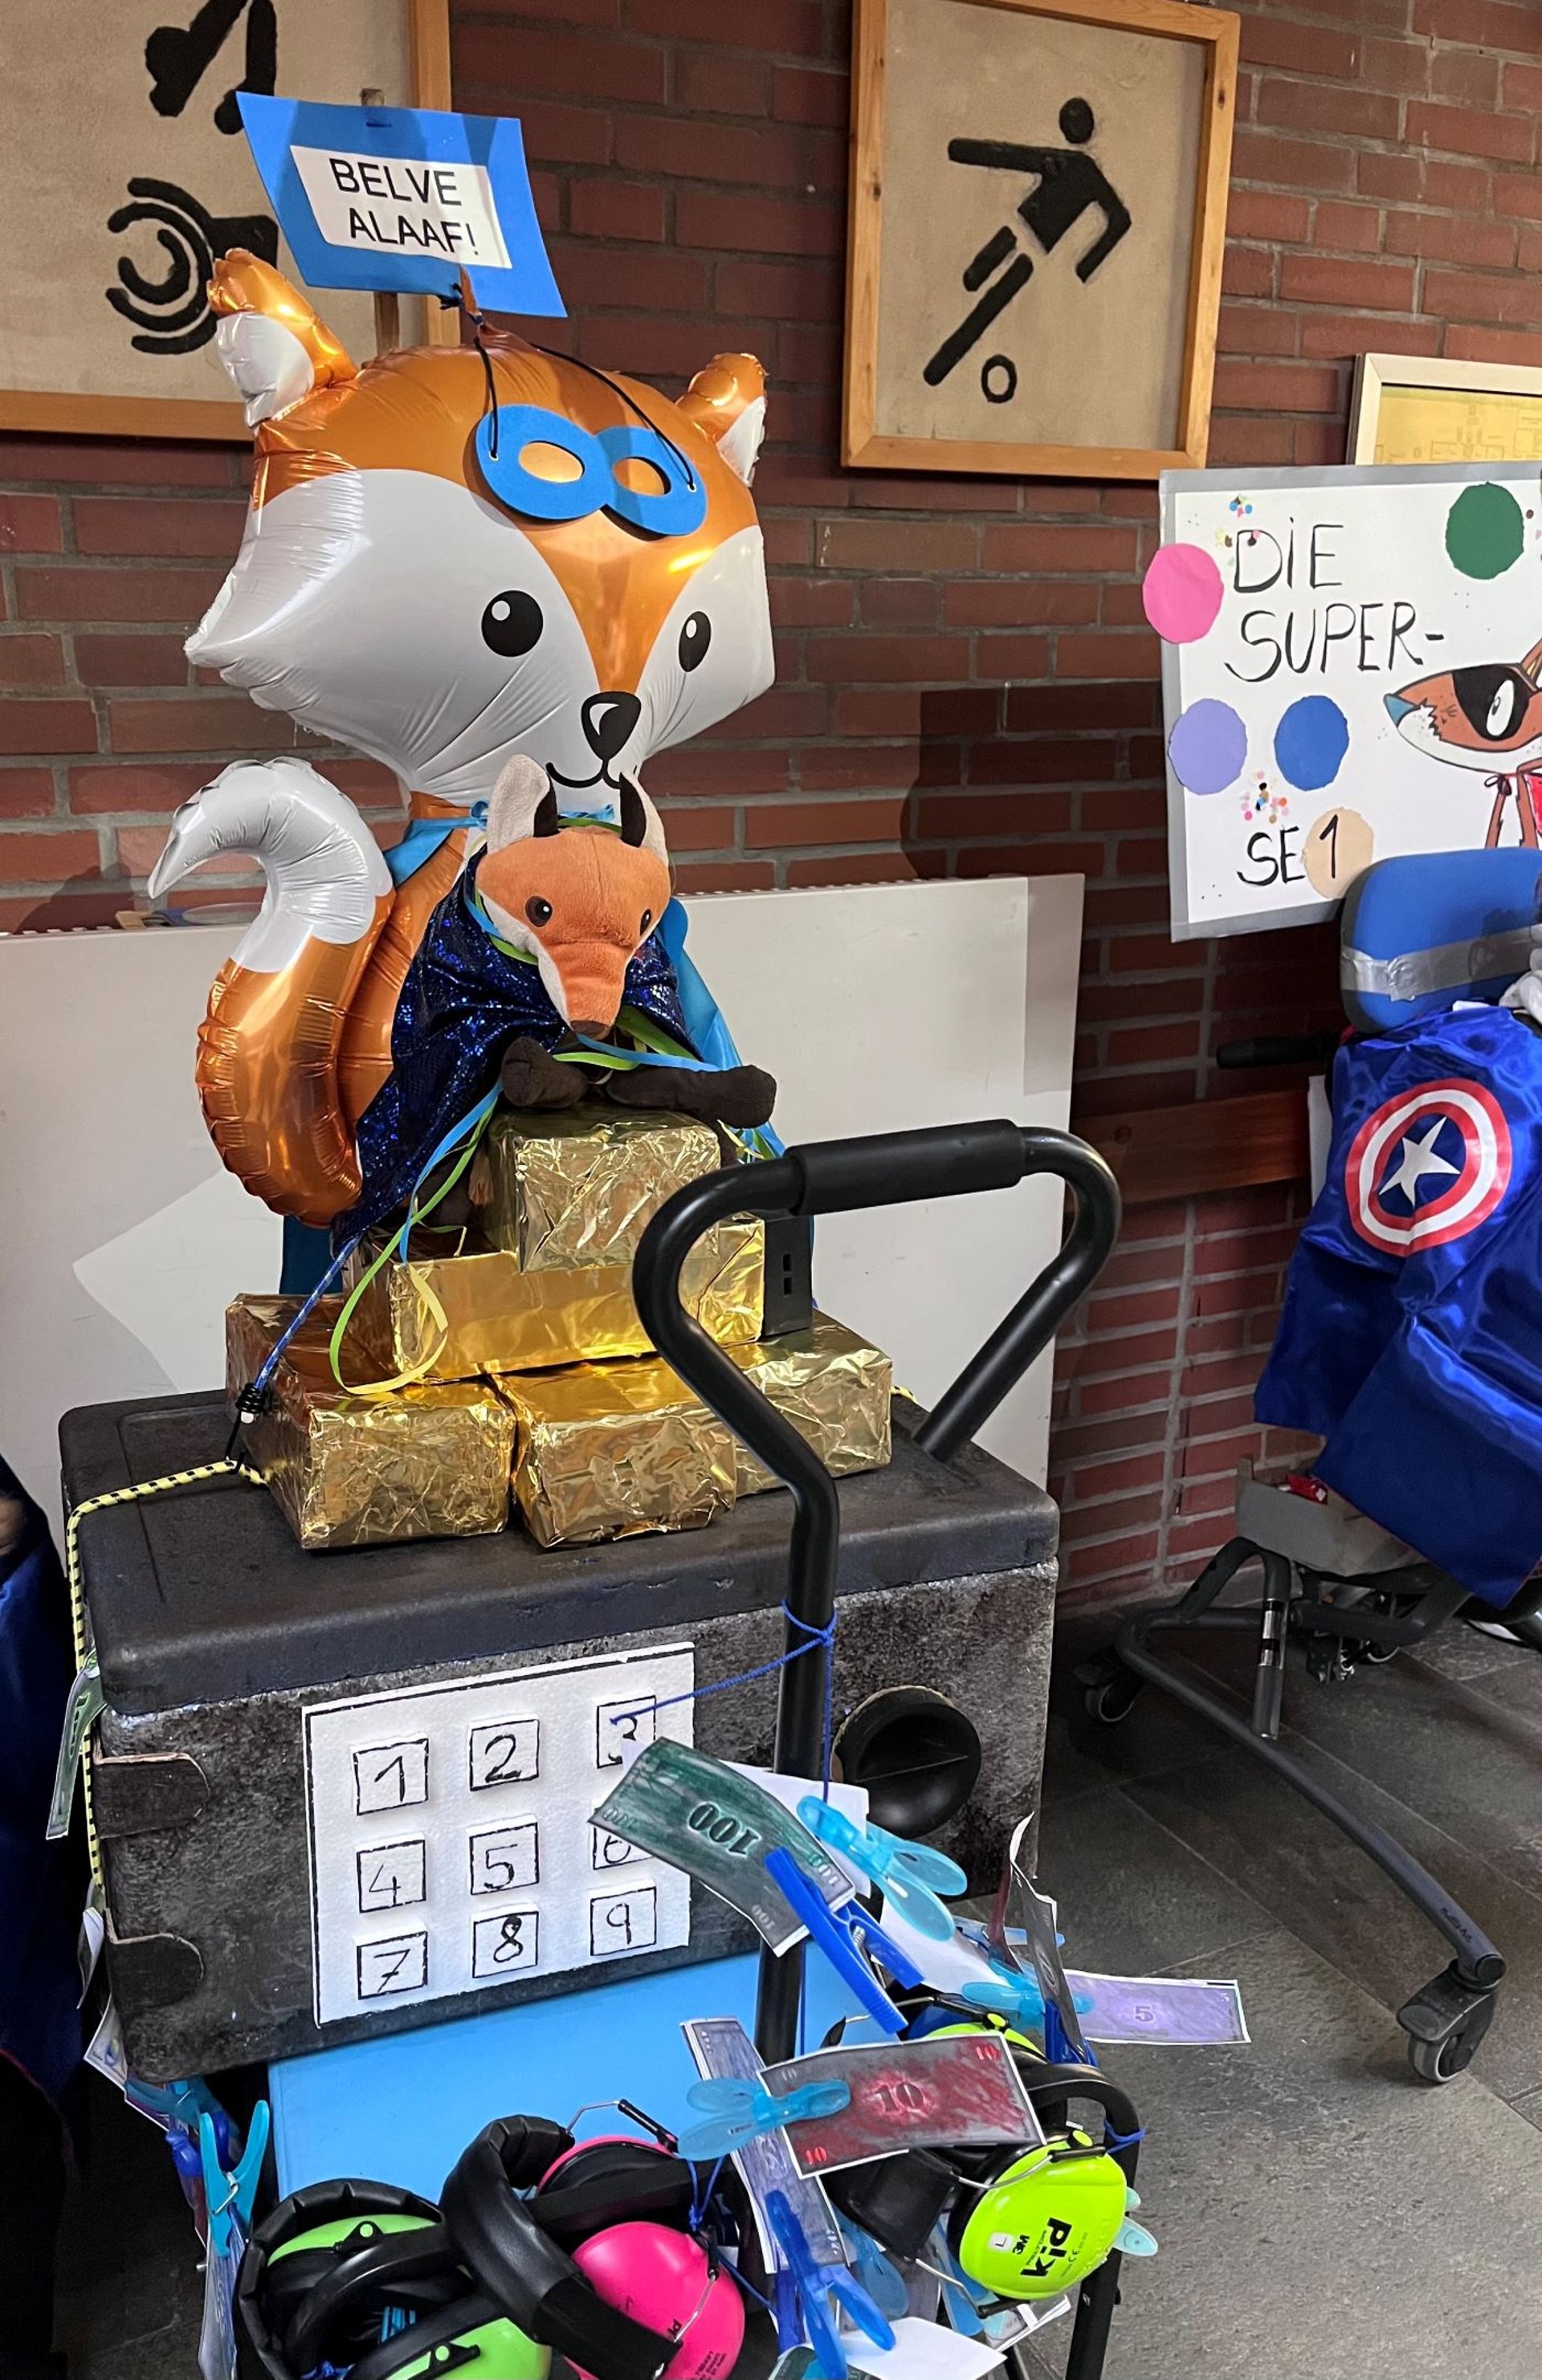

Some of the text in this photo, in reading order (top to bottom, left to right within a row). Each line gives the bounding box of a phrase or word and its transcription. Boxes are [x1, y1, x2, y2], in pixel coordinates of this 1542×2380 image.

[329, 157, 463, 206] BELVE
[349, 207, 480, 256] ALAAF!
[1224, 601, 1445, 683] SUPER-
[373, 1754, 406, 1803] 1
[483, 1733, 523, 1782] 2
[687, 1801, 762, 1857] 100
[368, 1863, 402, 1905] 4
[483, 1844, 519, 1889] 5
[372, 1902, 632, 1993] 7 8 9
[1133, 2004, 1155, 2023] 5
[874, 2080, 925, 2113] 10
[1012, 2234, 1030, 2255] 3M
[1020, 2217, 1073, 2277] kid
